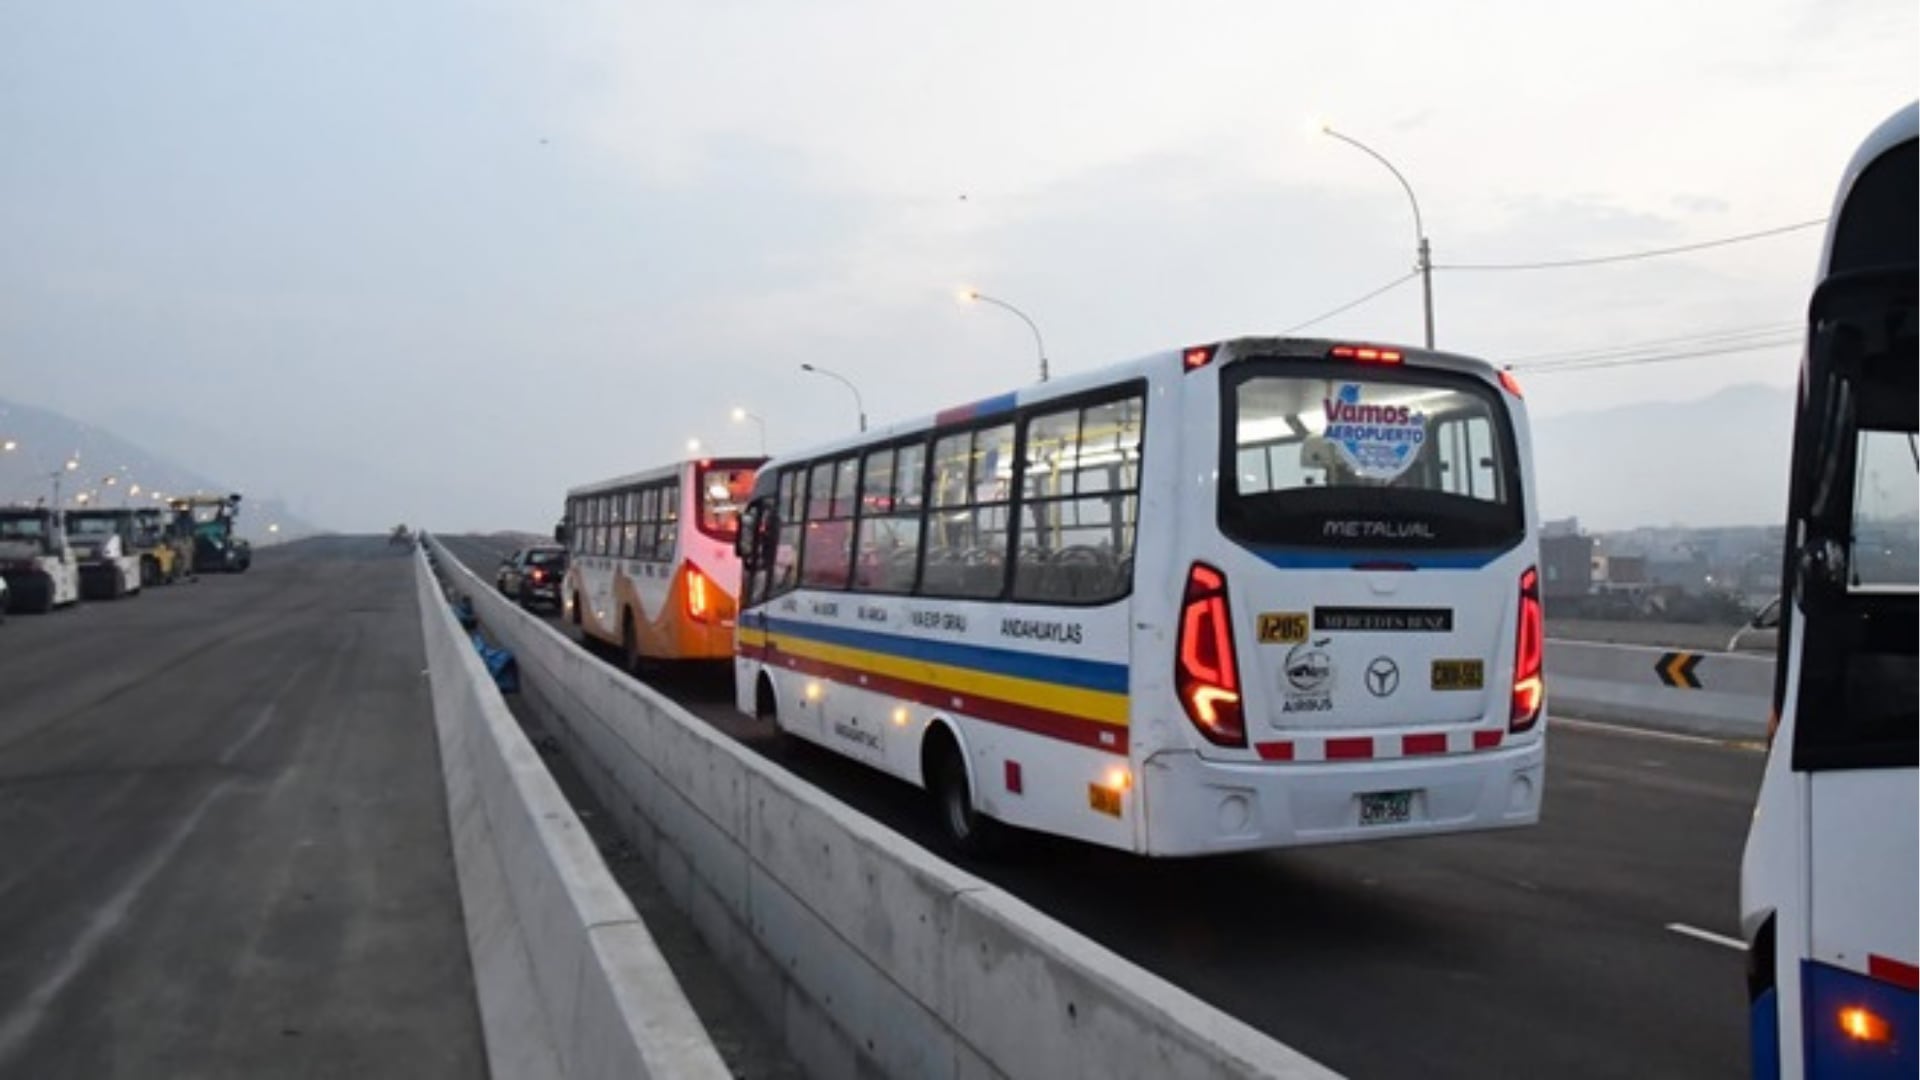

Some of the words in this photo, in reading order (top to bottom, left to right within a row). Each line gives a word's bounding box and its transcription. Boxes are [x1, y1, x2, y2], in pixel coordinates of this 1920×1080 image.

[1323, 398, 1409, 424] Vamos
[1324, 425, 1423, 443] AEROPUERTO
[1323, 520, 1436, 538] METALVAL
[1001, 617, 1083, 644] ANDAHUAYLAS
[1324, 614, 1404, 630] MERCEDES
